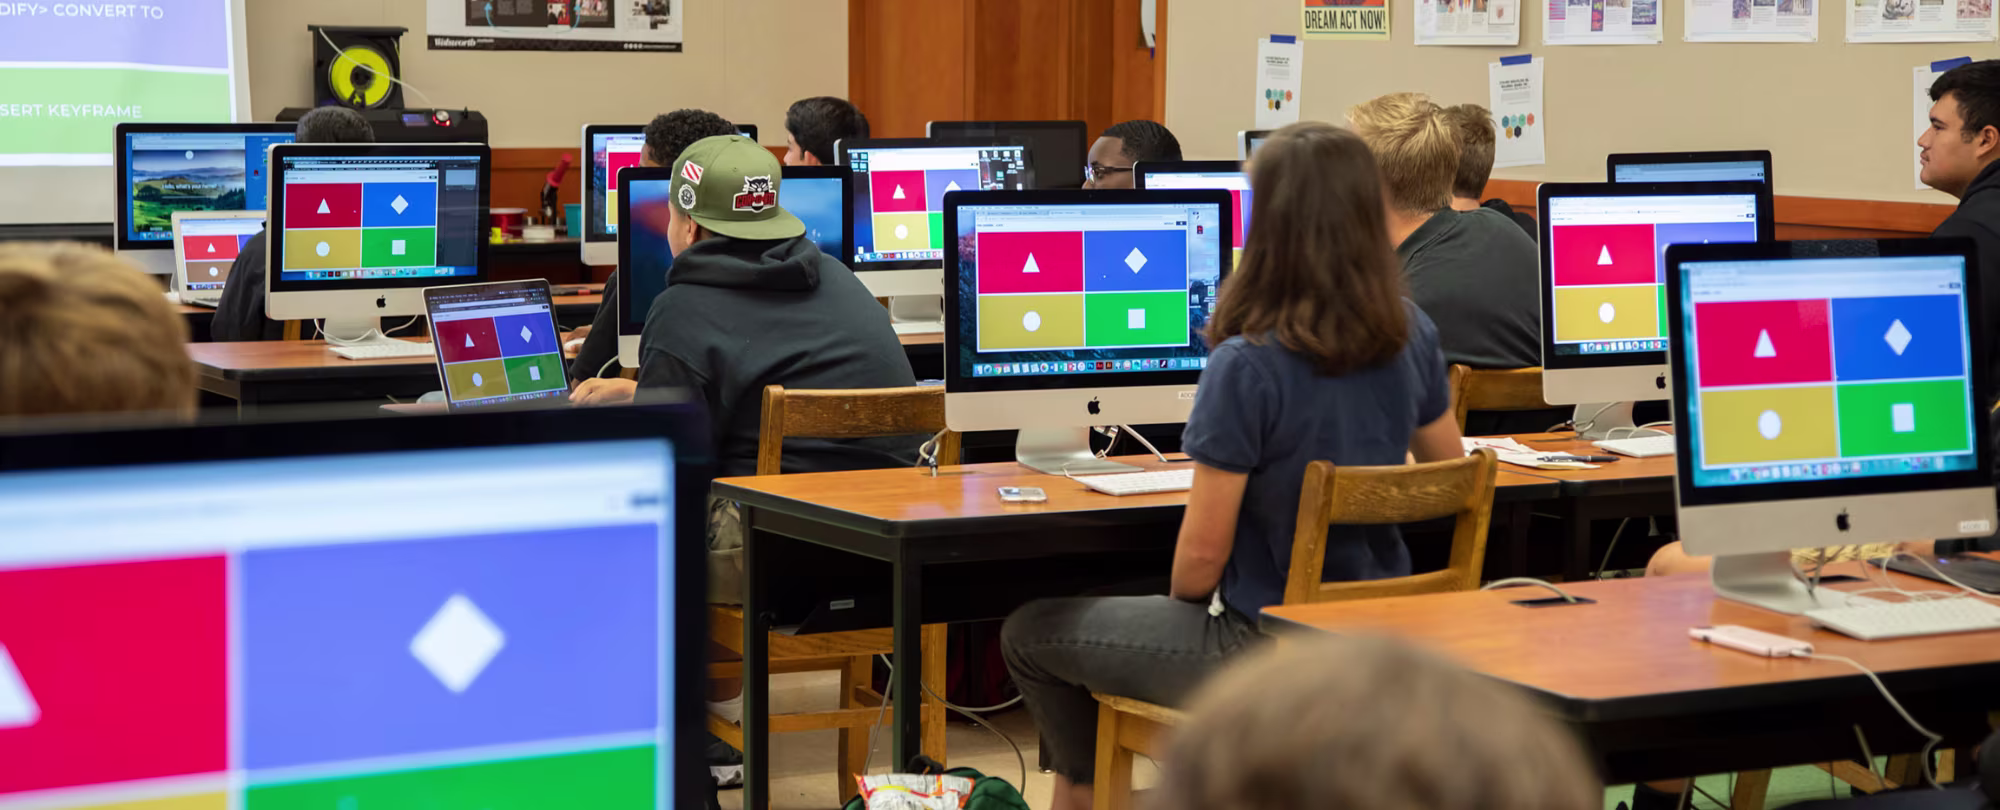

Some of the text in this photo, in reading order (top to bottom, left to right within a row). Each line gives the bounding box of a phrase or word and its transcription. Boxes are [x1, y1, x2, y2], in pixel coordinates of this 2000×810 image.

[53, 3, 136, 17] CONVERT
[140, 5, 164, 19] TO
[1304, 10, 1386, 29] DREAM ACT NOW!
[0, 103, 143, 118] SERT KEYFRAME
